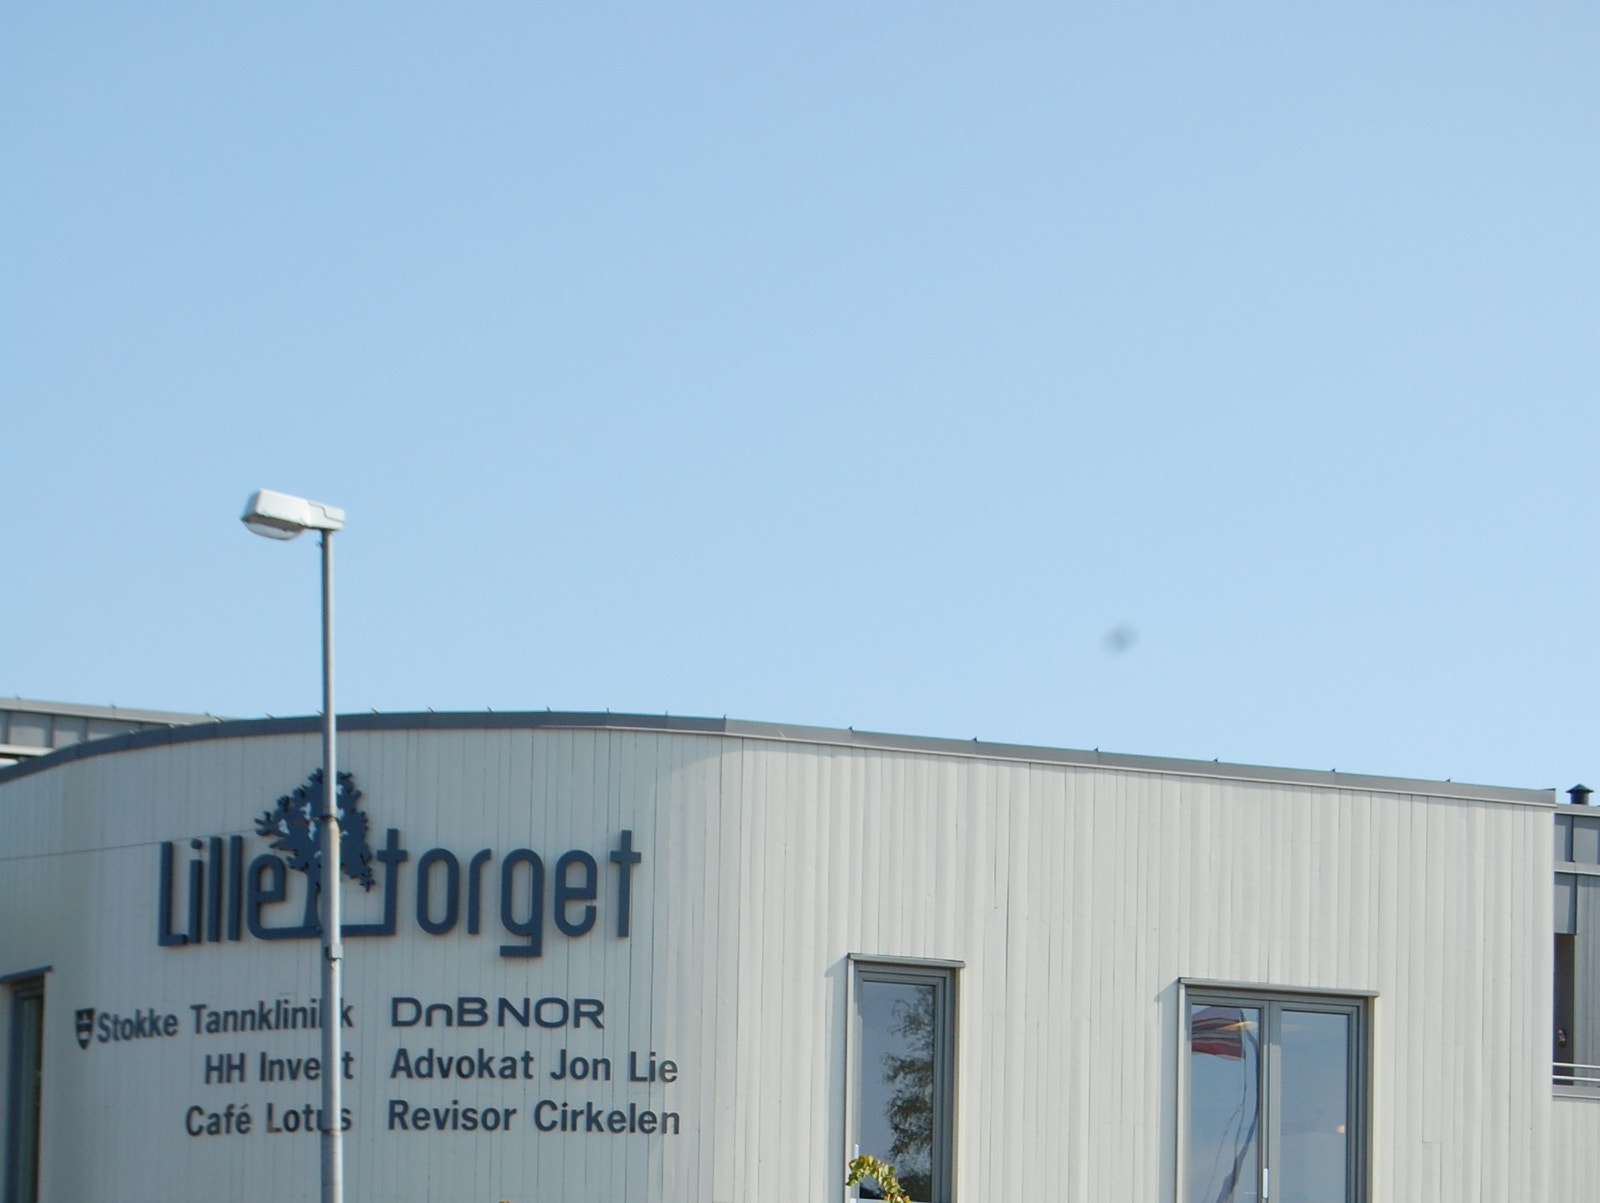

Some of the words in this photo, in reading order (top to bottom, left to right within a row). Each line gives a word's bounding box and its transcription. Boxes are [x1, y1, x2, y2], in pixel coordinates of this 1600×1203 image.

[158, 835, 288, 946] Lille
[376, 828, 641, 957] torget
[97, 1008, 178, 1043] Stokke
[191, 998, 353, 1034] Tannklinik
[205, 1052, 246, 1084] HH
[260, 1051, 353, 1082] Invet
[390, 1048, 534, 1079] Advokat
[550, 1048, 611, 1080] Jon
[630, 1051, 678, 1083] Lie
[186, 1104, 252, 1136] Café
[388, 1100, 517, 1131] Revisor
[534, 1100, 680, 1135] Cirkelen
